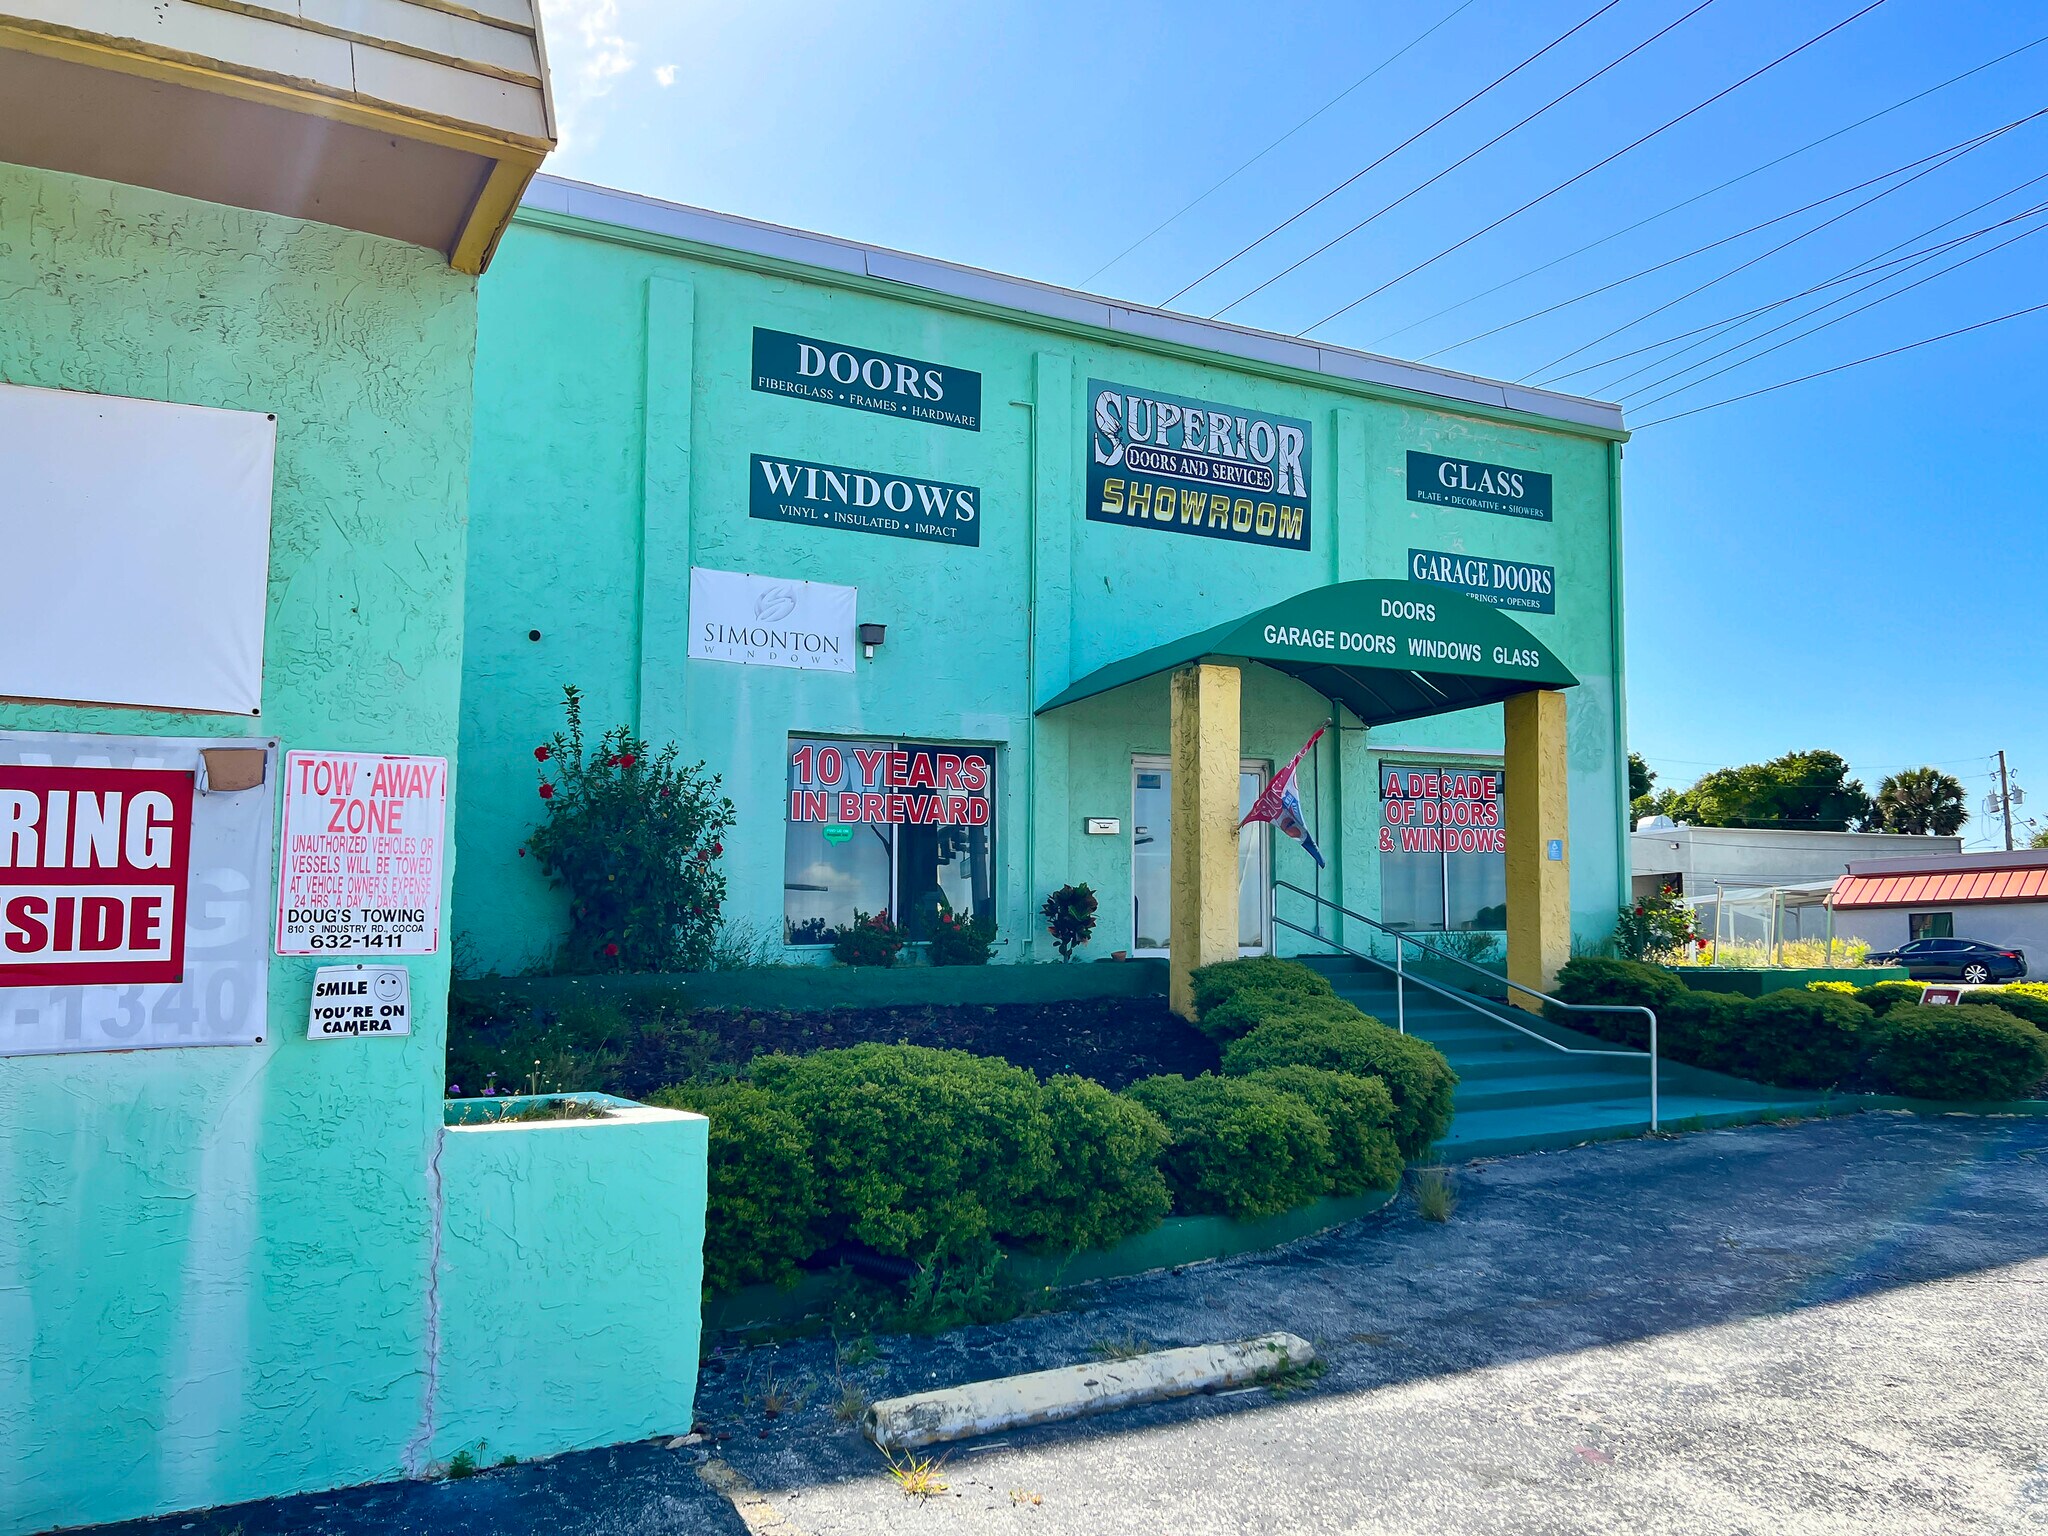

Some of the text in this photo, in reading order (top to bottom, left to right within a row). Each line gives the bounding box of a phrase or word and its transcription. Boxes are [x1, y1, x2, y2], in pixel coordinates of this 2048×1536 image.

[796, 343, 944, 401] DOORS
[758, 376, 976, 427] FIBERGLASS FRAMES HARDWARE
[1094, 390, 1307, 498] SUPERIOR
[1129, 448, 1270, 488] DOORS AND SERVICES
[1439, 462, 1524, 498] GLASS
[760, 460, 975, 522] WINDOWS
[1418, 490, 1543, 517] PLATE DECORATIVE SHOWERS
[779, 505, 957, 537] VINYL INSULATED IMPACT
[1101, 478, 1303, 540] SHOWROOM
[1413, 554, 1551, 595] GARAGE DOORS
[1381, 599, 1436, 622] DOORS
[1507, 597, 1540, 608] OPENERS
[705, 623, 839, 653] SIMONTON
[1264, 624, 1540, 667] GARAGE DOORS WINDOWS GLASS
[298, 760, 437, 798] TOW AWAY
[793, 746, 842, 785] 10
[852, 749, 987, 791] YEARS
[1385, 772, 1496, 800] A DECADE
[327, 798, 404, 834] ZONE
[791, 790, 990, 825] IN BREVARD
[1385, 799, 1498, 826] OF DOORS
[0, 789, 174, 870] RING
[1379, 826, 1506, 854] & WINDOWS
[292, 835, 433, 855] UNAUTHORIZED VEHICLES OR
[292, 856, 432, 874] VESSELS WILL BE TOWED
[290, 876, 431, 895] AT VEHICLE OWNER'S EXPENSE
[288, 909, 425, 923] DOUG'S TOWING
[294, 895, 306, 908] 24
[311, 895, 331, 908] HRS.
[336, 895, 342, 908] A
[347, 895, 363, 908] DAY
[368, 895, 373, 908] 7
[377, 895, 398, 908] DAYS
[403, 895, 409, 908] A
[0, 896, 162, 953] SIDE
[288, 925, 304, 933] 810
[309, 925, 315, 933] S
[322, 925, 366, 933] INDUSTRY
[392, 925, 423, 933] COCOA
[310, 934, 402, 949] 632-1411
[316, 981, 368, 997] SMILE
[314, 1005, 405, 1020] YOU'RE ON
[323, 1019, 392, 1033] CAMERA
